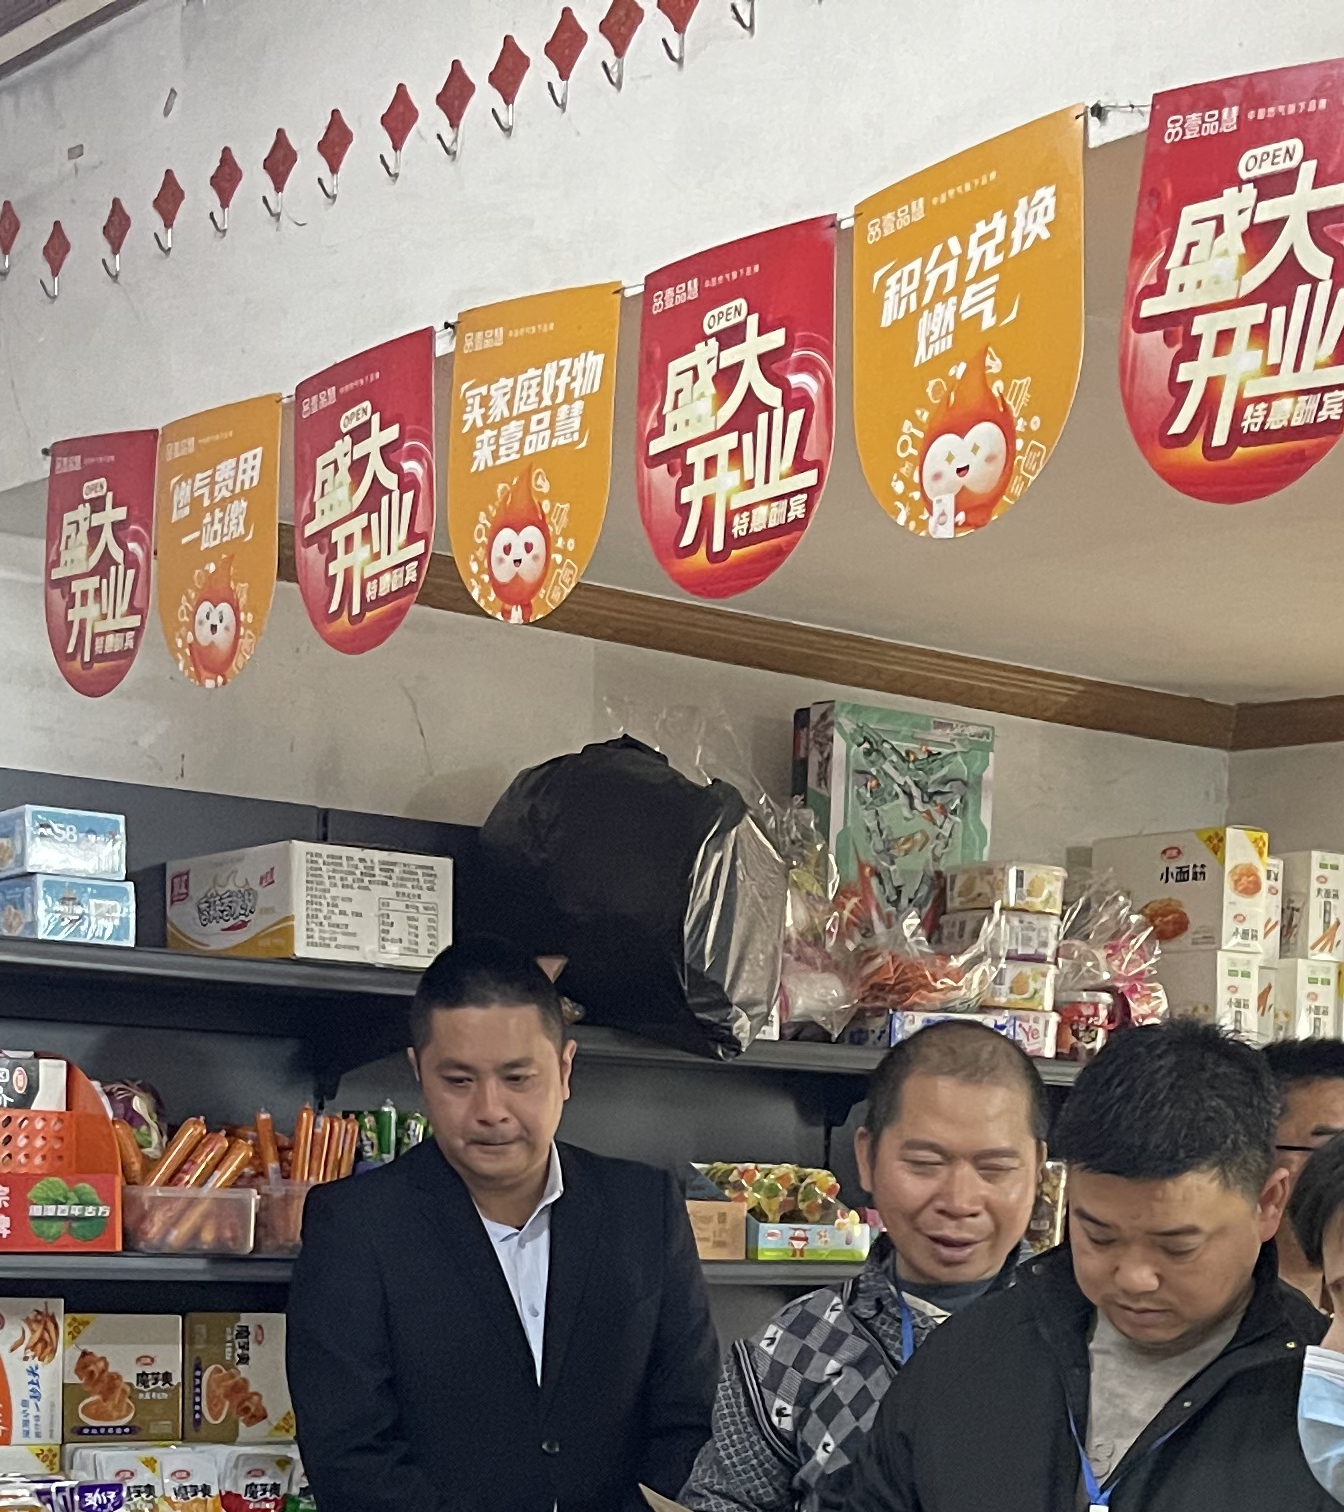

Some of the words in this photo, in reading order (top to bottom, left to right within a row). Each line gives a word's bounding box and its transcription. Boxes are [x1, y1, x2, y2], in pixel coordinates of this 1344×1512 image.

[1245, 144, 1296, 172] OPEN
[707, 302, 744, 330] OPEN
[648, 313, 786, 457] 盛大
[342, 404, 369, 429] OPEN
[85, 482, 105, 497] OPEN
[304, 412, 400, 538] 盛大
[679, 406, 818, 553] 开业
[730, 493, 808, 539] 特惠酬宾
[51, 491, 127, 580] 盛大
[328, 488, 425, 616] 开业
[365, 561, 418, 602] 特惠酬宾
[67, 564, 141, 662] 开业
[1160, 864, 1206, 883] 小面筋
[136, 1369, 174, 1390] 魔芋爽
[83, 1490, 120, 1511] 劲仔
[244, 1483, 282, 1500] 魔芋爽
